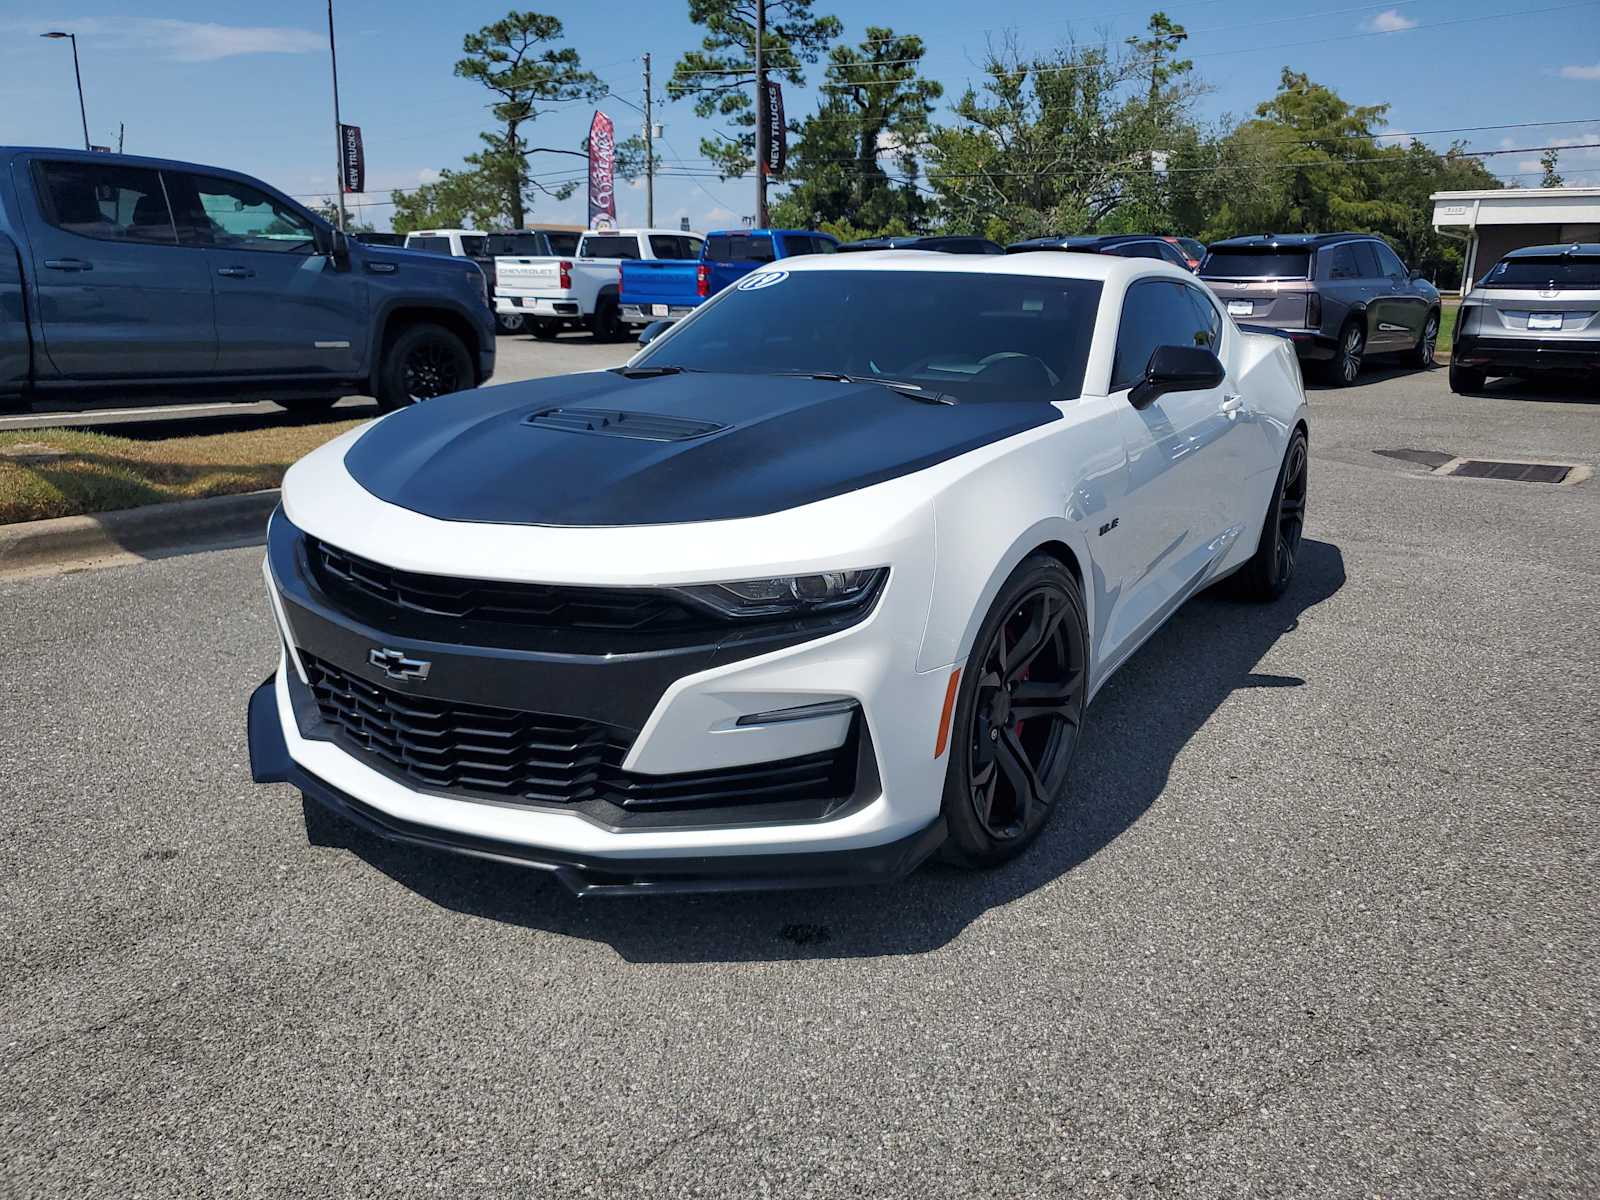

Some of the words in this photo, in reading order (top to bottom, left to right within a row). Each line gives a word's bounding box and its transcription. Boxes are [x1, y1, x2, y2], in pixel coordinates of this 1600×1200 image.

[768, 86, 780, 138] TRUCKS
[346, 128, 358, 167] TRUCKS
[598, 130, 611, 178] YEARS
[769, 140, 780, 169] NEW
[349, 167, 359, 189] NEW
